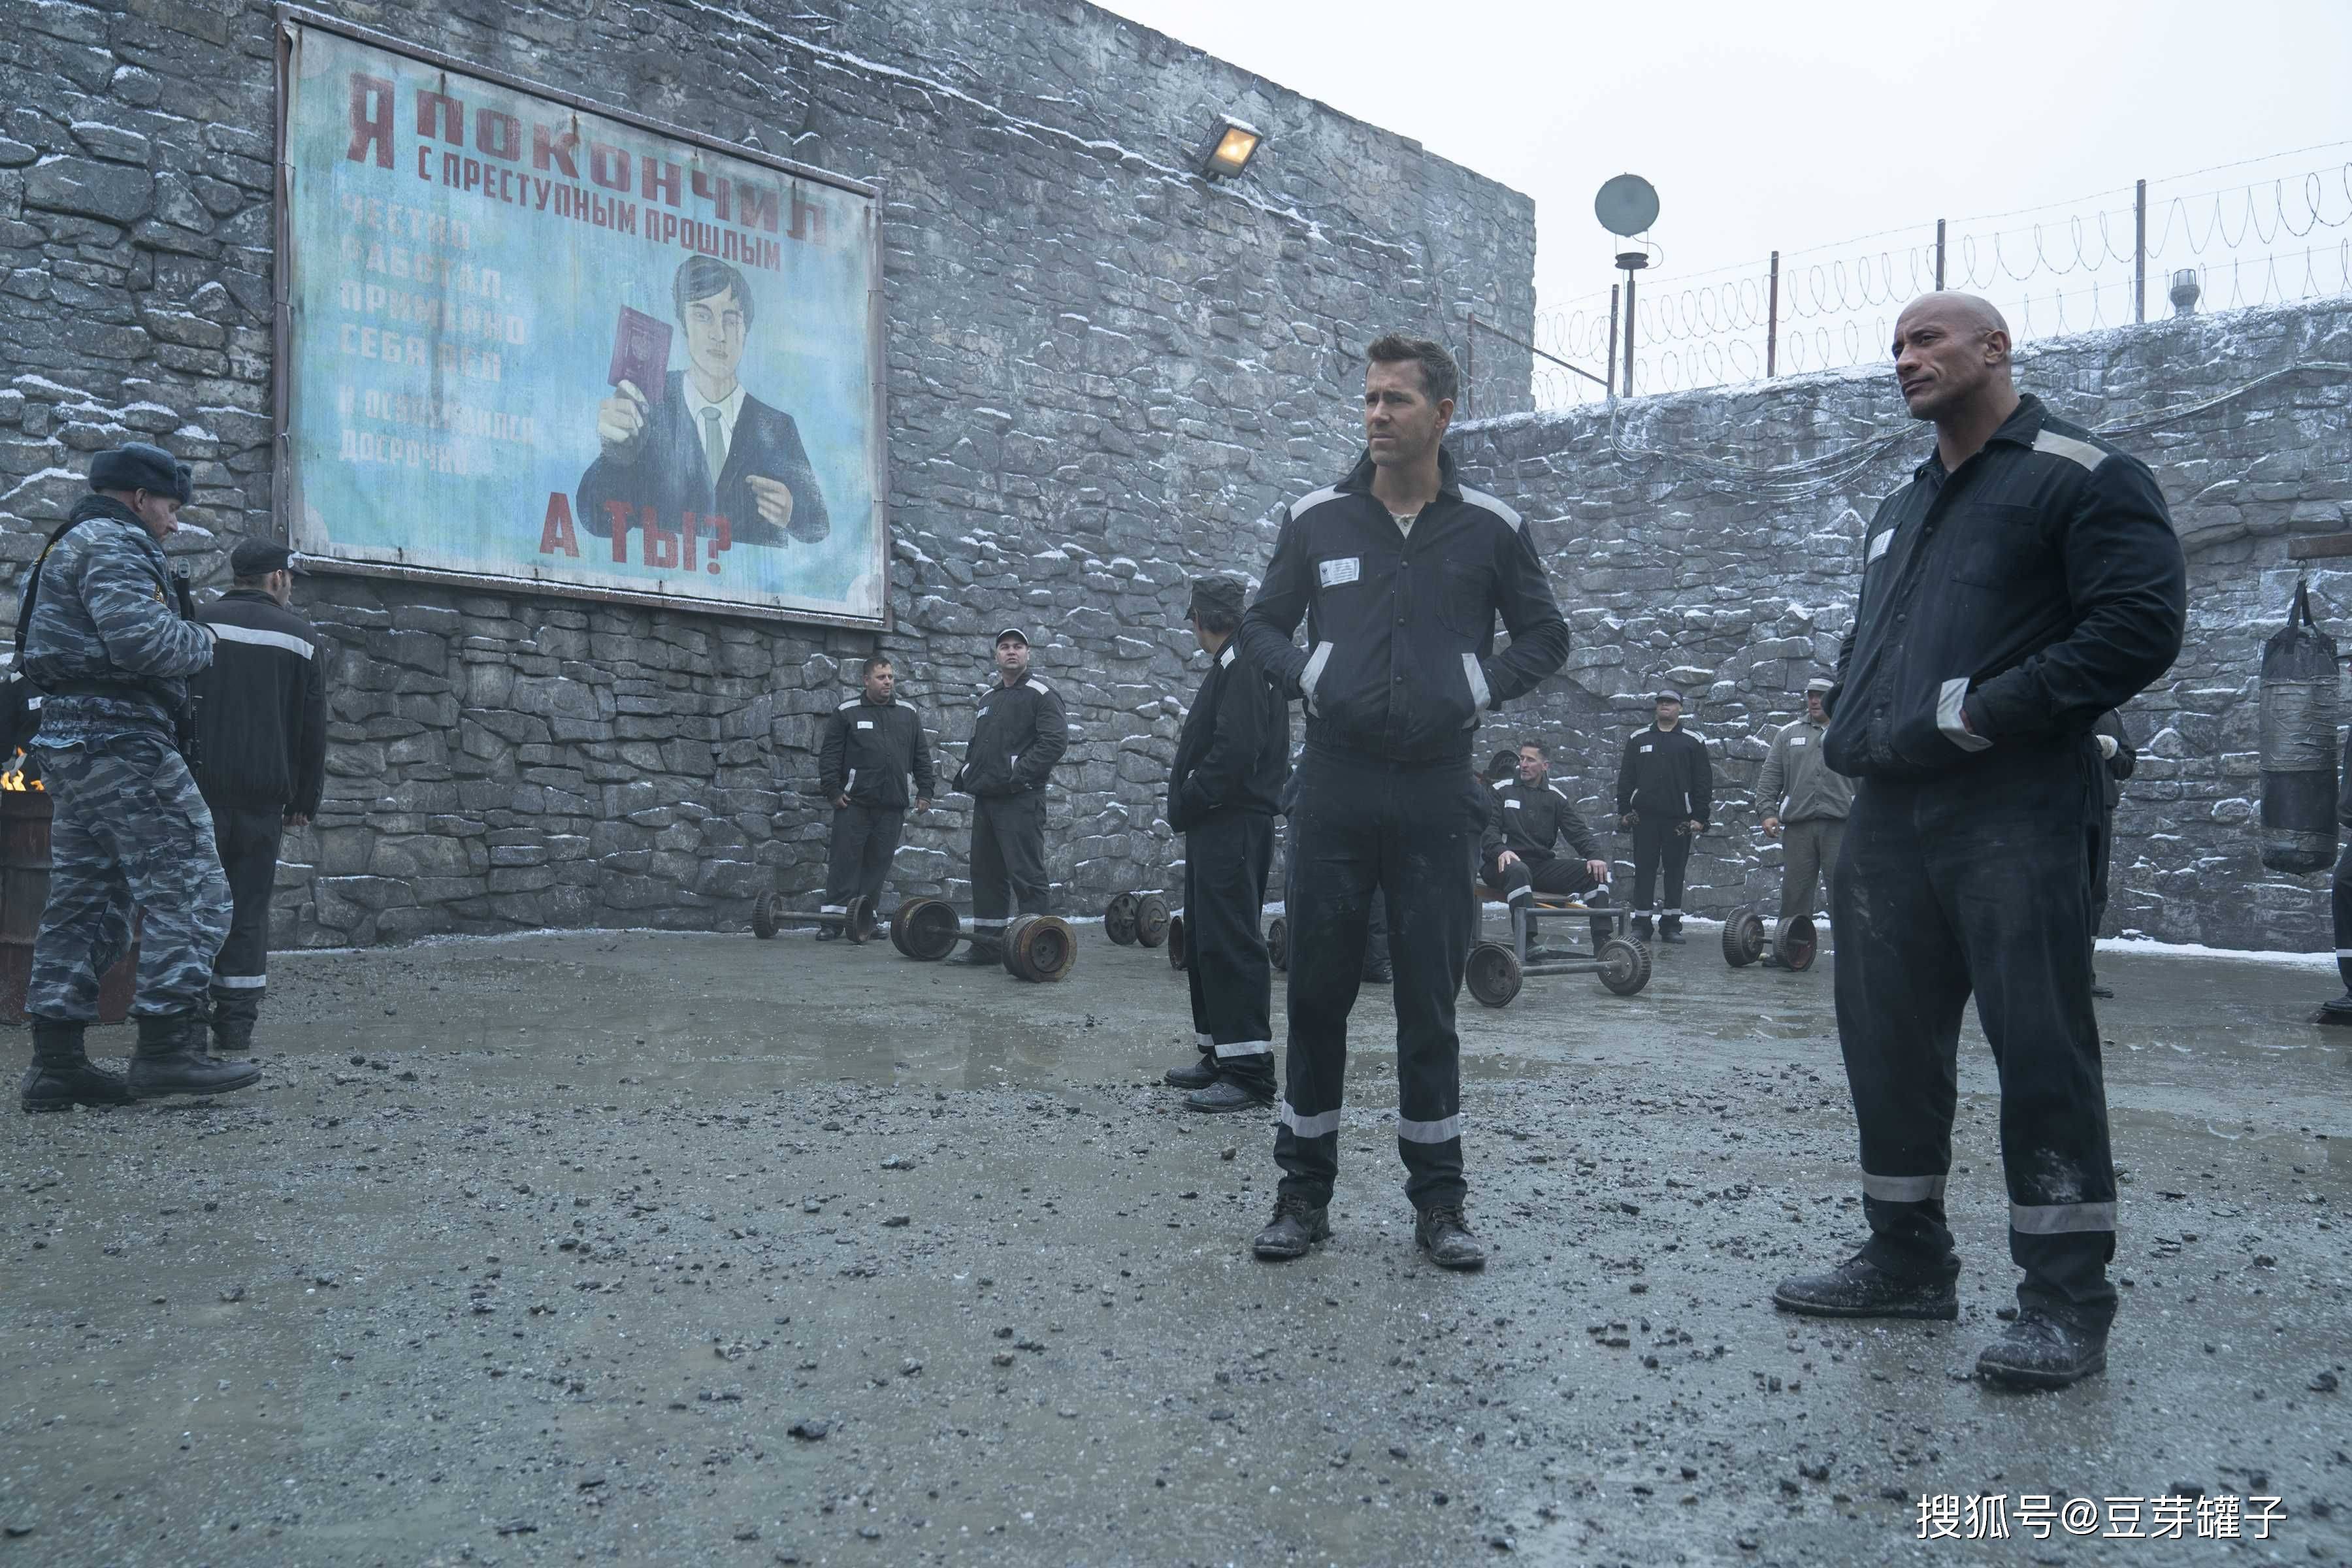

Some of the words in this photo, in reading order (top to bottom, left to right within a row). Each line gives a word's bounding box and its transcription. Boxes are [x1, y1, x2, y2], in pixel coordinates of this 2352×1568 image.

[347, 73, 393, 170] Я
[416, 89, 826, 246] ПОКОНЧИЛ
[340, 193, 470, 250] ЧЕСТНО
[418, 145, 432, 181] С
[443, 148, 636, 235] ПРЕСТУПНЫМ
[645, 208, 780, 272] ПРОШЛЫМ
[339, 323, 425, 366] СЕБЯ
[540, 492, 580, 557] А
[604, 500, 732, 576] ТЫ?
